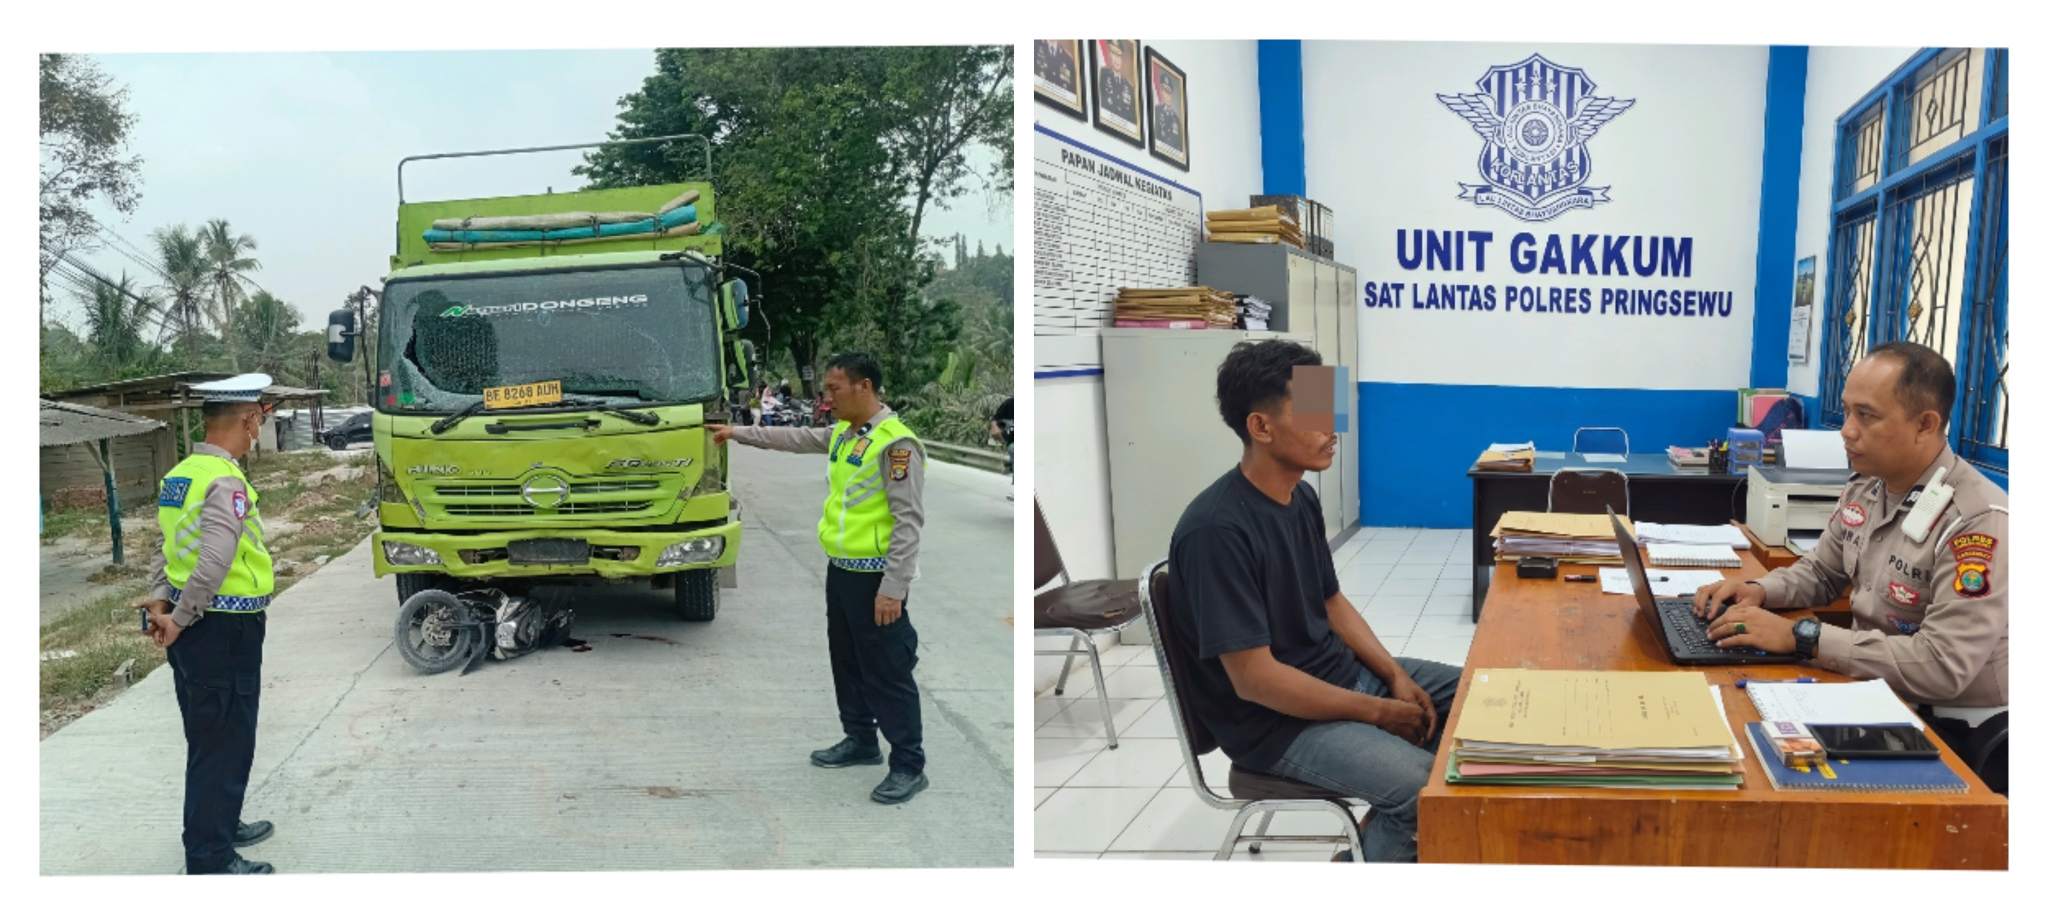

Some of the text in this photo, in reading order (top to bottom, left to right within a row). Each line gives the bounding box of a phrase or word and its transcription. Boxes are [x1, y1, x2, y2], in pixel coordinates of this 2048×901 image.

[1061, 148, 1096, 174] PAPAN
[1097, 163, 1134, 188] JADWAL
[1490, 156, 1580, 187] KORLANTAS
[1396, 228, 1694, 278] UNIT GAKKUM
[1364, 280, 1733, 317] SAT LANTAS POLRES PRINGSEWU
[485, 389, 501, 402] BE
[503, 385, 534, 401] 8268
[1888, 554, 1931, 583] POLRI
